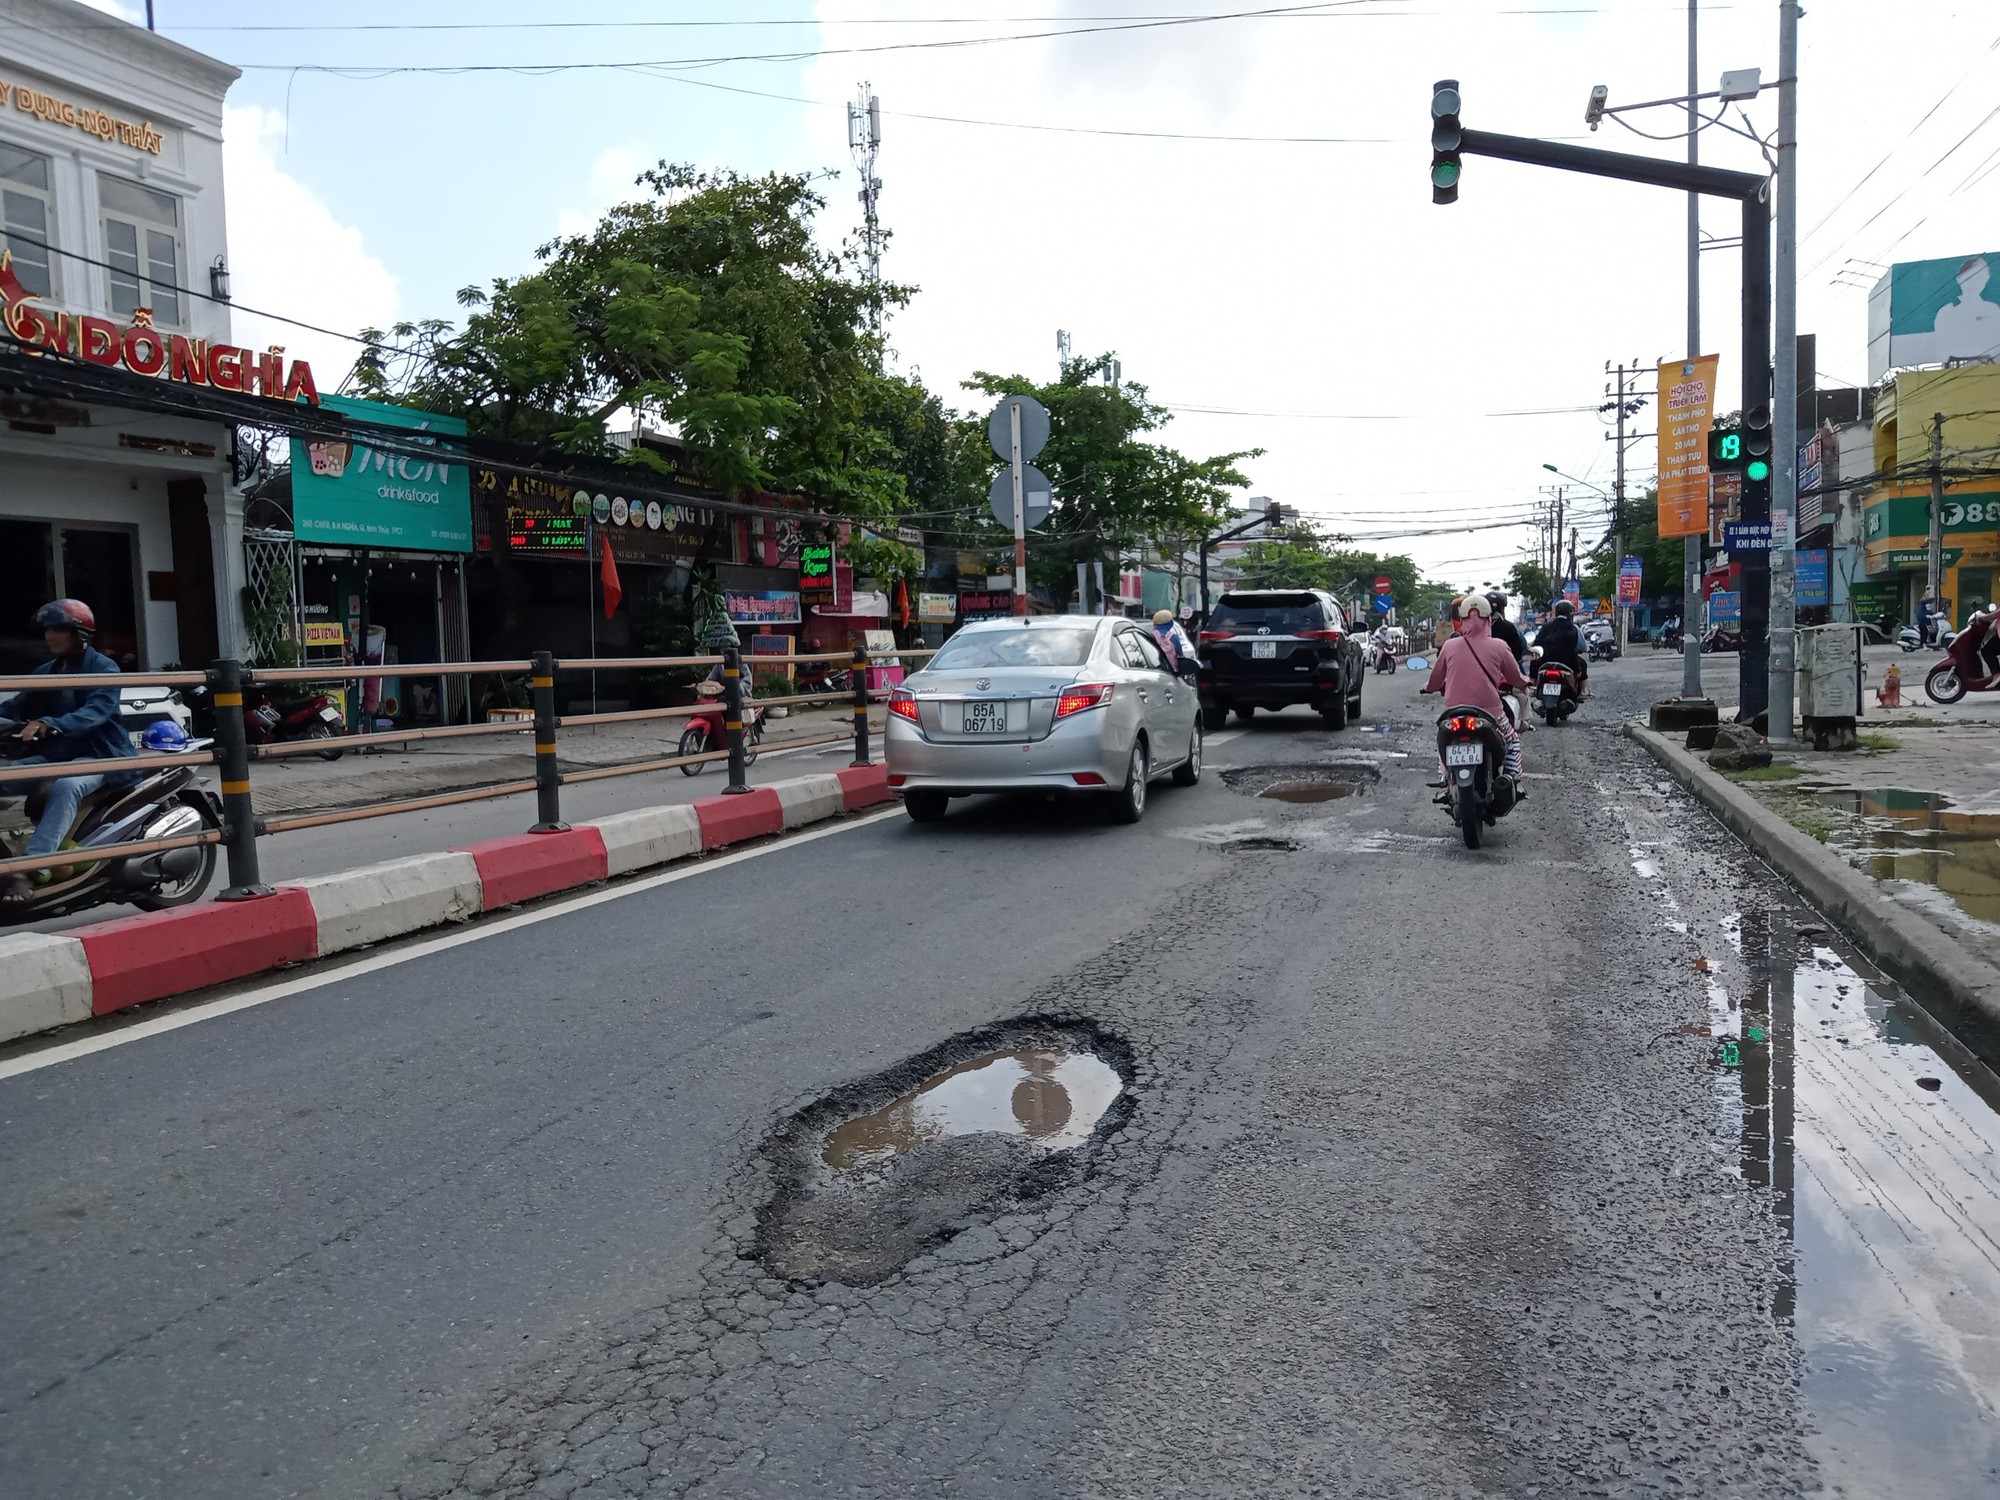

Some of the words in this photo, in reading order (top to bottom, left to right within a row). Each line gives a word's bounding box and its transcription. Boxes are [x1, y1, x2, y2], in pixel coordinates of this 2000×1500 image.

[120, 120, 163, 155] THẤT
[79, 306, 164, 377] ĐỖ
[168, 345, 319, 405] NGHĨA
[1674, 441, 1683, 450] 20
[1722, 434, 1740, 459] 19
[377, 484, 440, 505] drink&food
[1729, 527, 1735, 535] XE
[1736, 539, 1750, 549] KHI
[1750, 537, 1766, 549] ĐÈN
[801, 545, 831, 560] Bánh
[803, 560, 828, 576] Kem
[963, 592, 991, 612] QUẢNG
[992, 593, 1010, 609] CÁO
[973, 704, 995, 717] 65A
[964, 718, 1004, 732] 067.19
